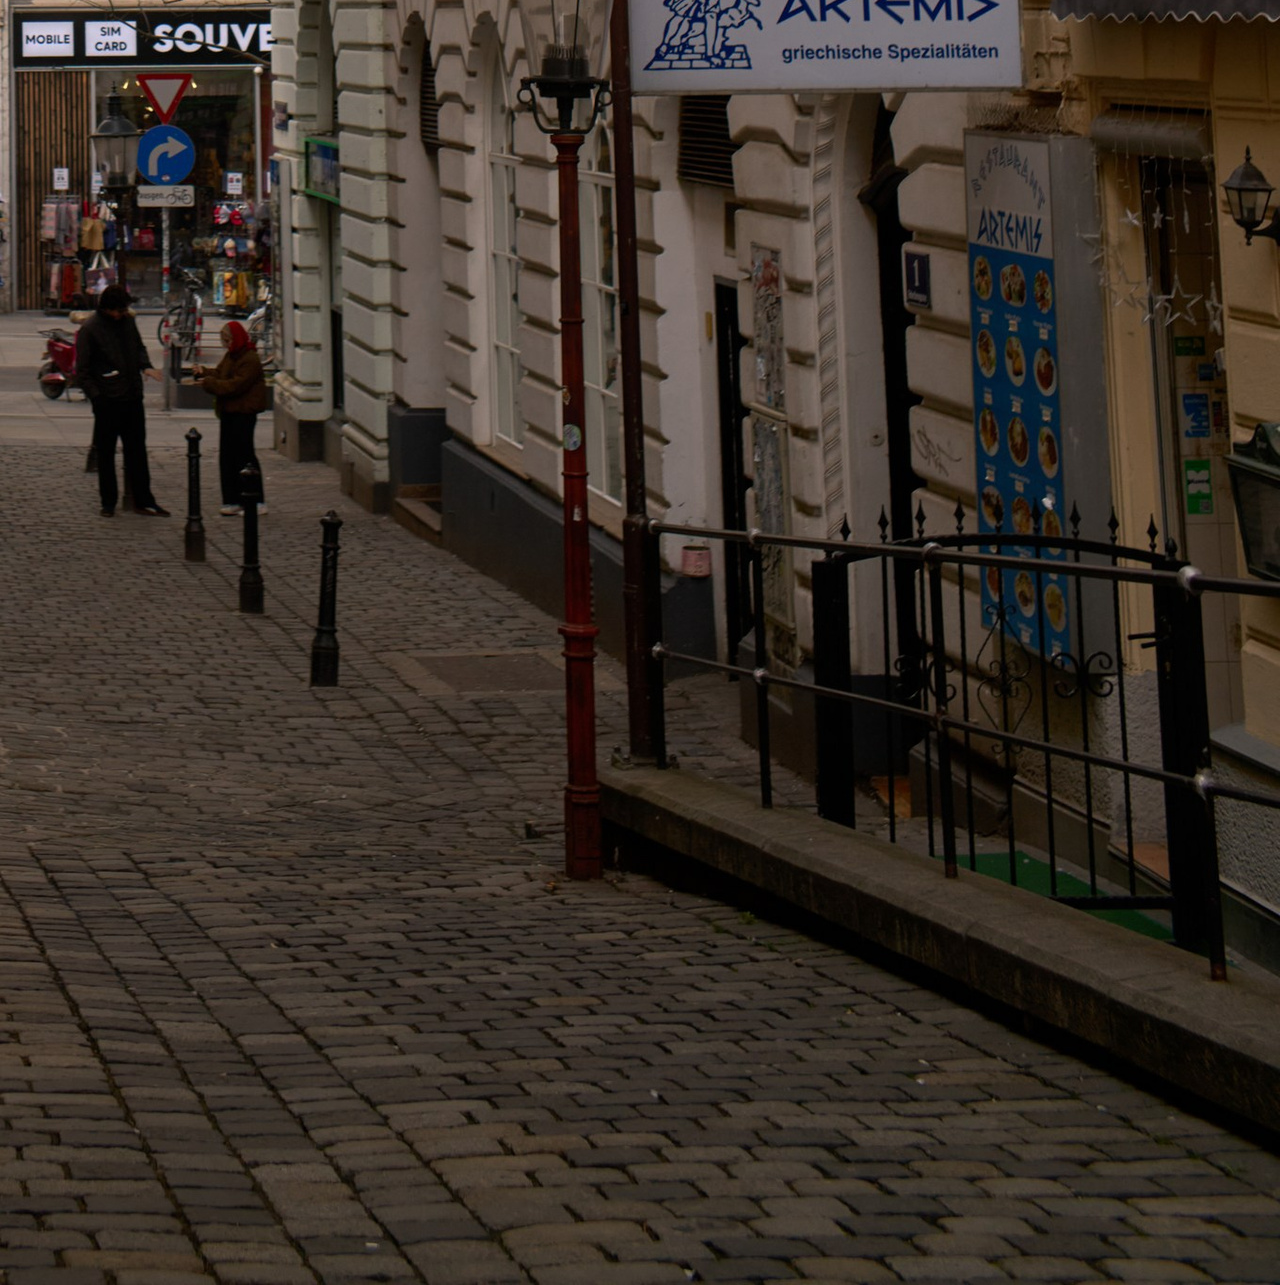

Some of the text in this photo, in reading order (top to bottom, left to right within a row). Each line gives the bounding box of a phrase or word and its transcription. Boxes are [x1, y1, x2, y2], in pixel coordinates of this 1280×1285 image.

[25, 34, 71, 45] MOBILE
[100, 26, 121, 37] SIM
[152, 22, 272, 53] SOUVE
[95, 41, 127, 51] CARD
[782, 43, 999, 64] griechische Spezialitäten
[970, 143, 1046, 210] RESTAURANT
[976, 206, 1043, 253] ARTEMIS
[913, 259, 920, 287] 1
